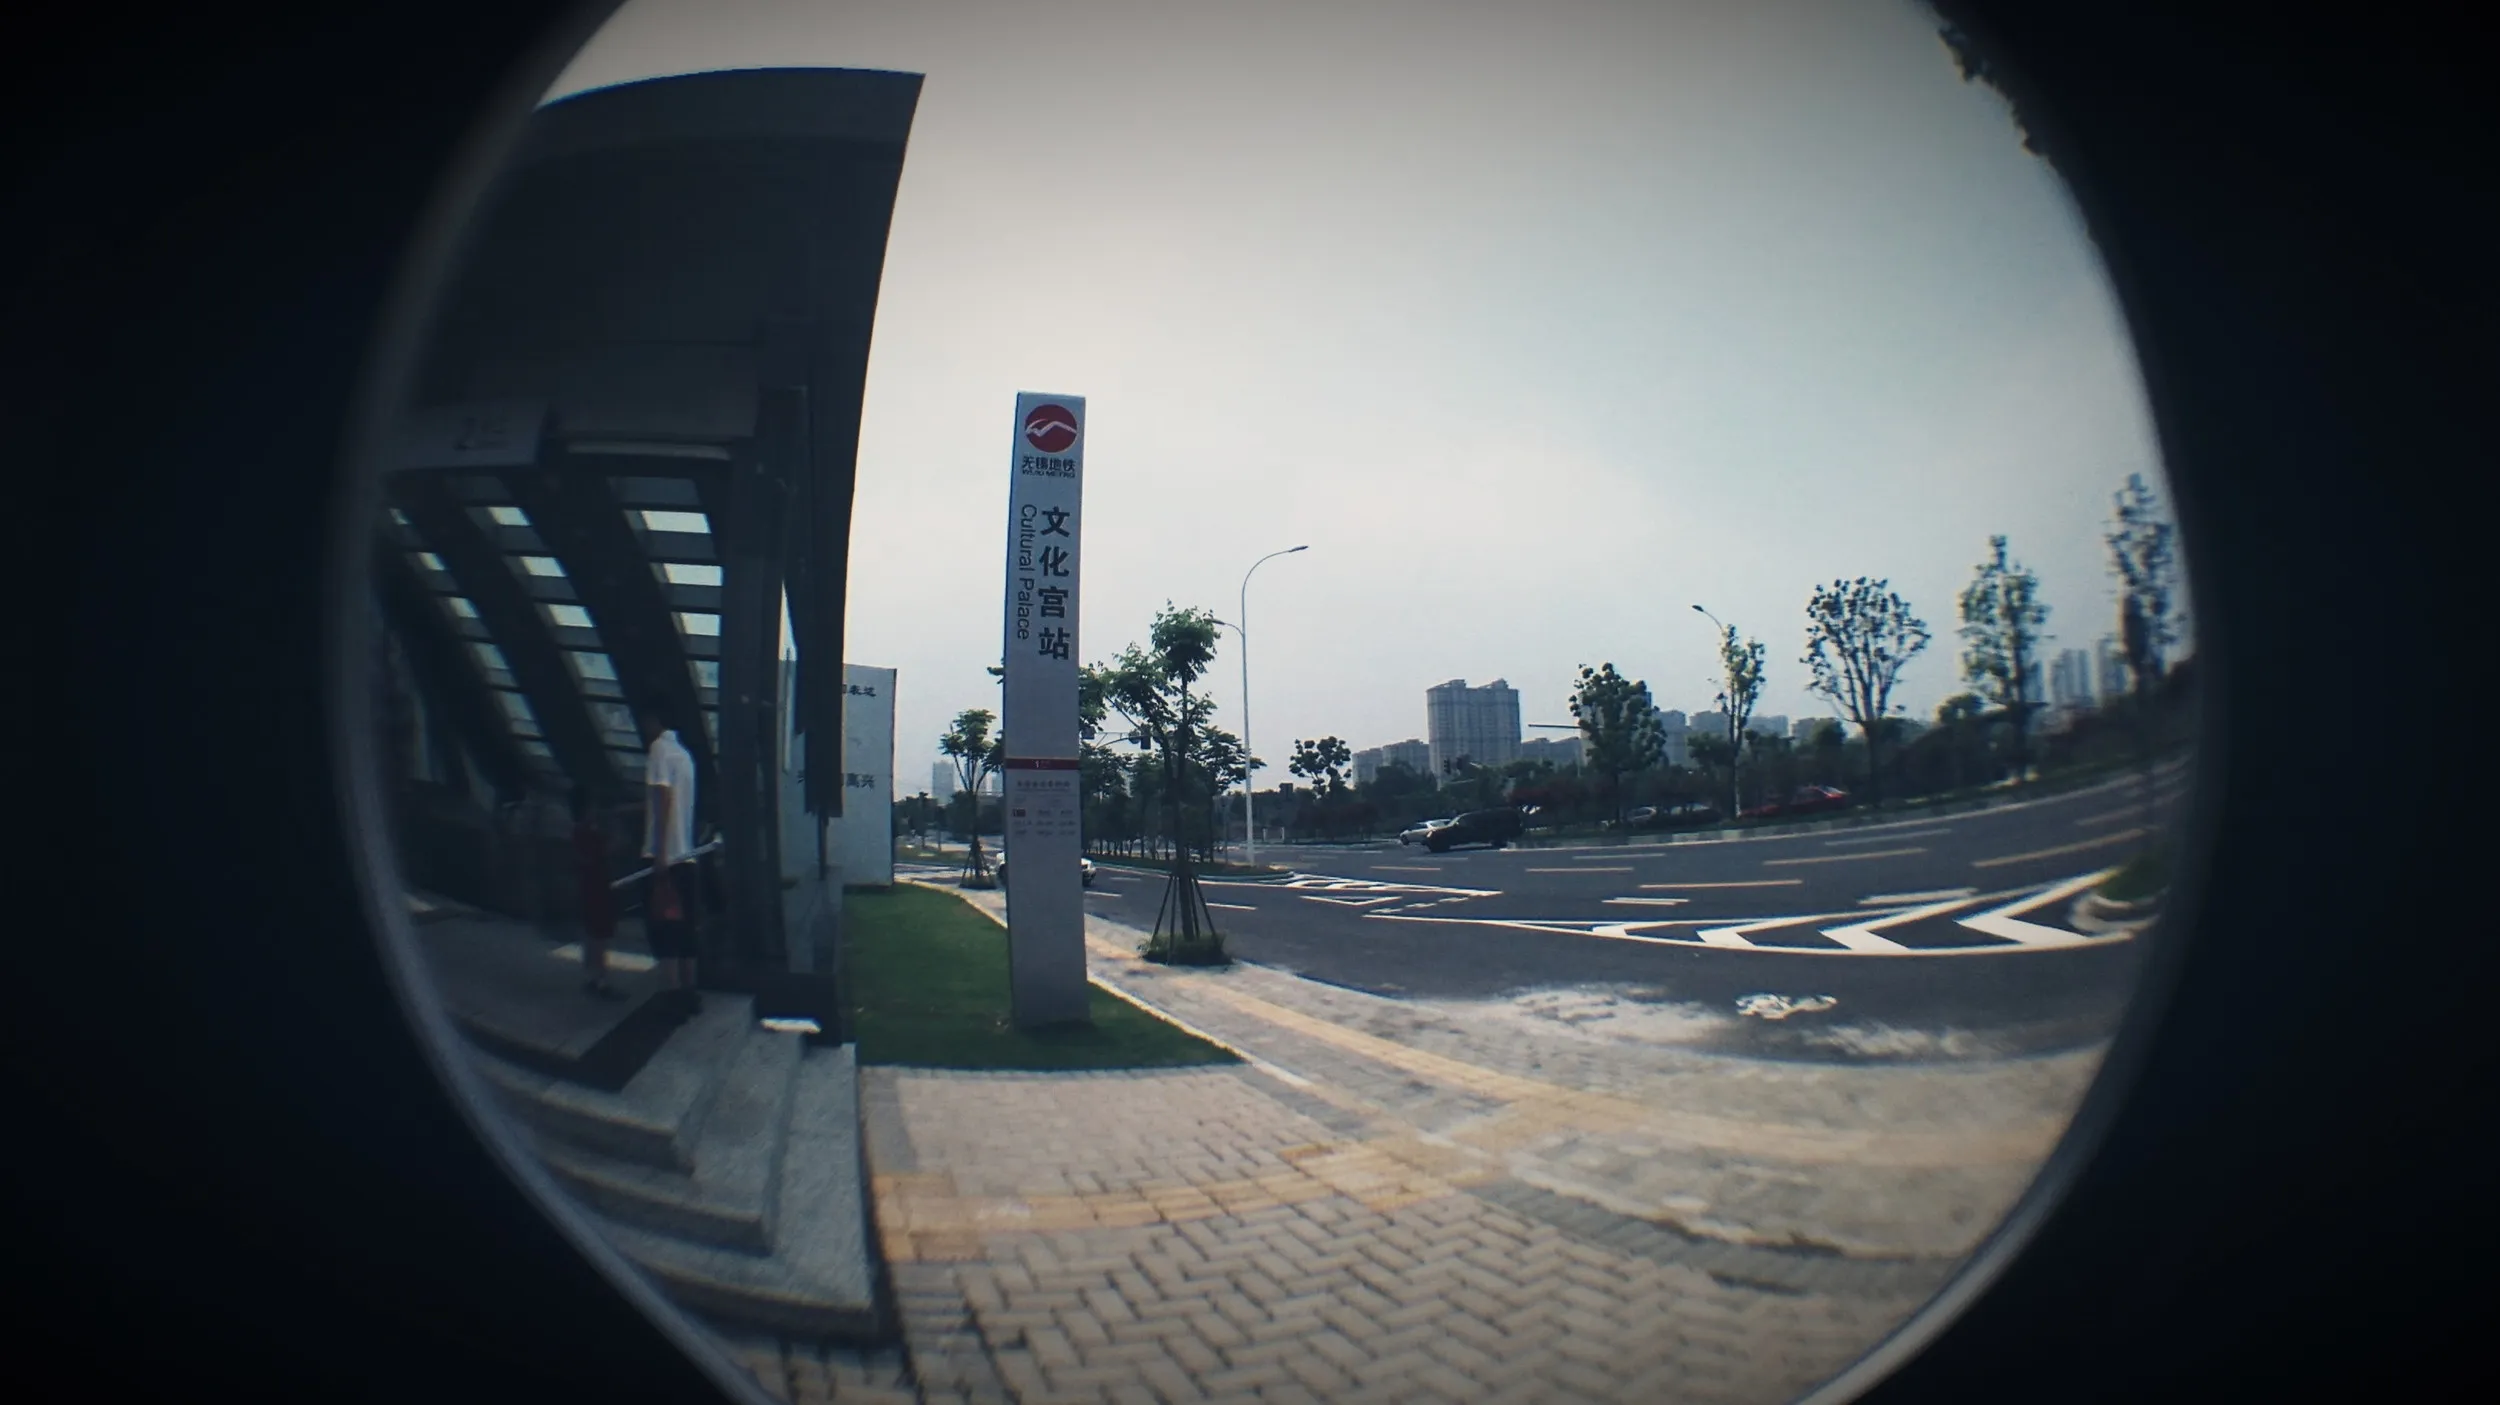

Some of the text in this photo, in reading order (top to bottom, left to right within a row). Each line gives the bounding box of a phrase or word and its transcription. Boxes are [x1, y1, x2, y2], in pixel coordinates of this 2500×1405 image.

[1022, 455, 1076, 471] 无锡地铁
[1017, 504, 1037, 640] Cultural Palace
[1038, 506, 1071, 660] 文化宫站
